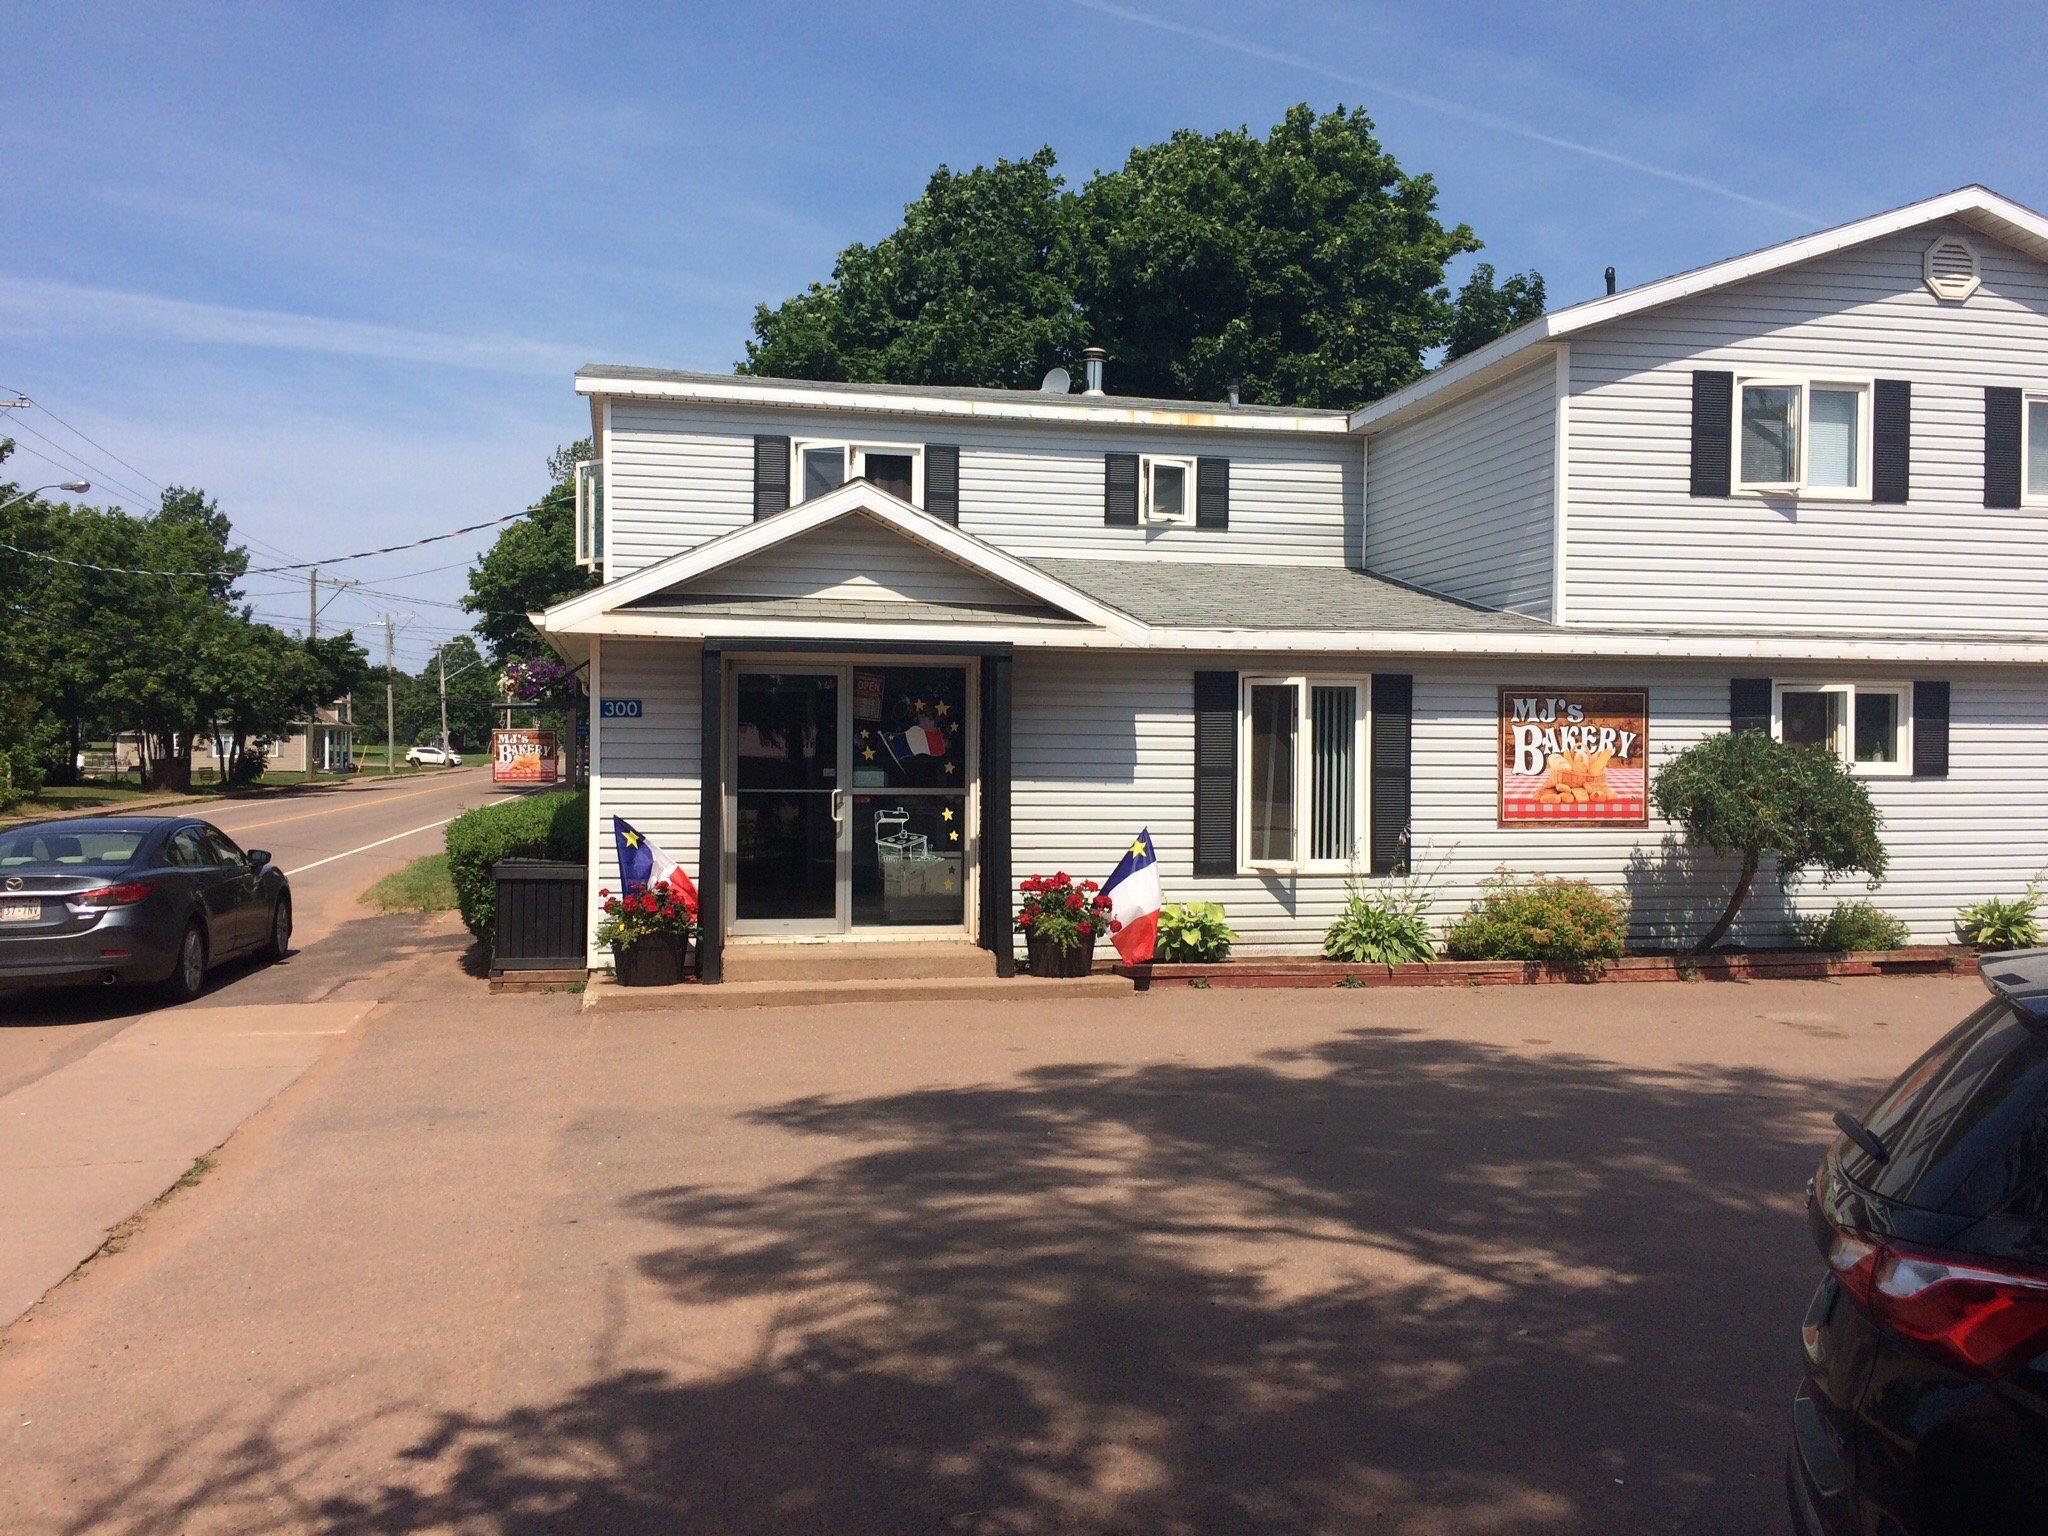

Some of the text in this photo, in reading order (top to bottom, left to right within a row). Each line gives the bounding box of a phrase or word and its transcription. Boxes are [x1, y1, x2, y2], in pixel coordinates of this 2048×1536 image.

[604, 701, 638, 716] 300
[1511, 698, 1583, 723] MJ's
[497, 733, 529, 744] MJ's
[498, 744, 551, 762] BAKERY
[1511, 725, 1637, 775] BAKERY
